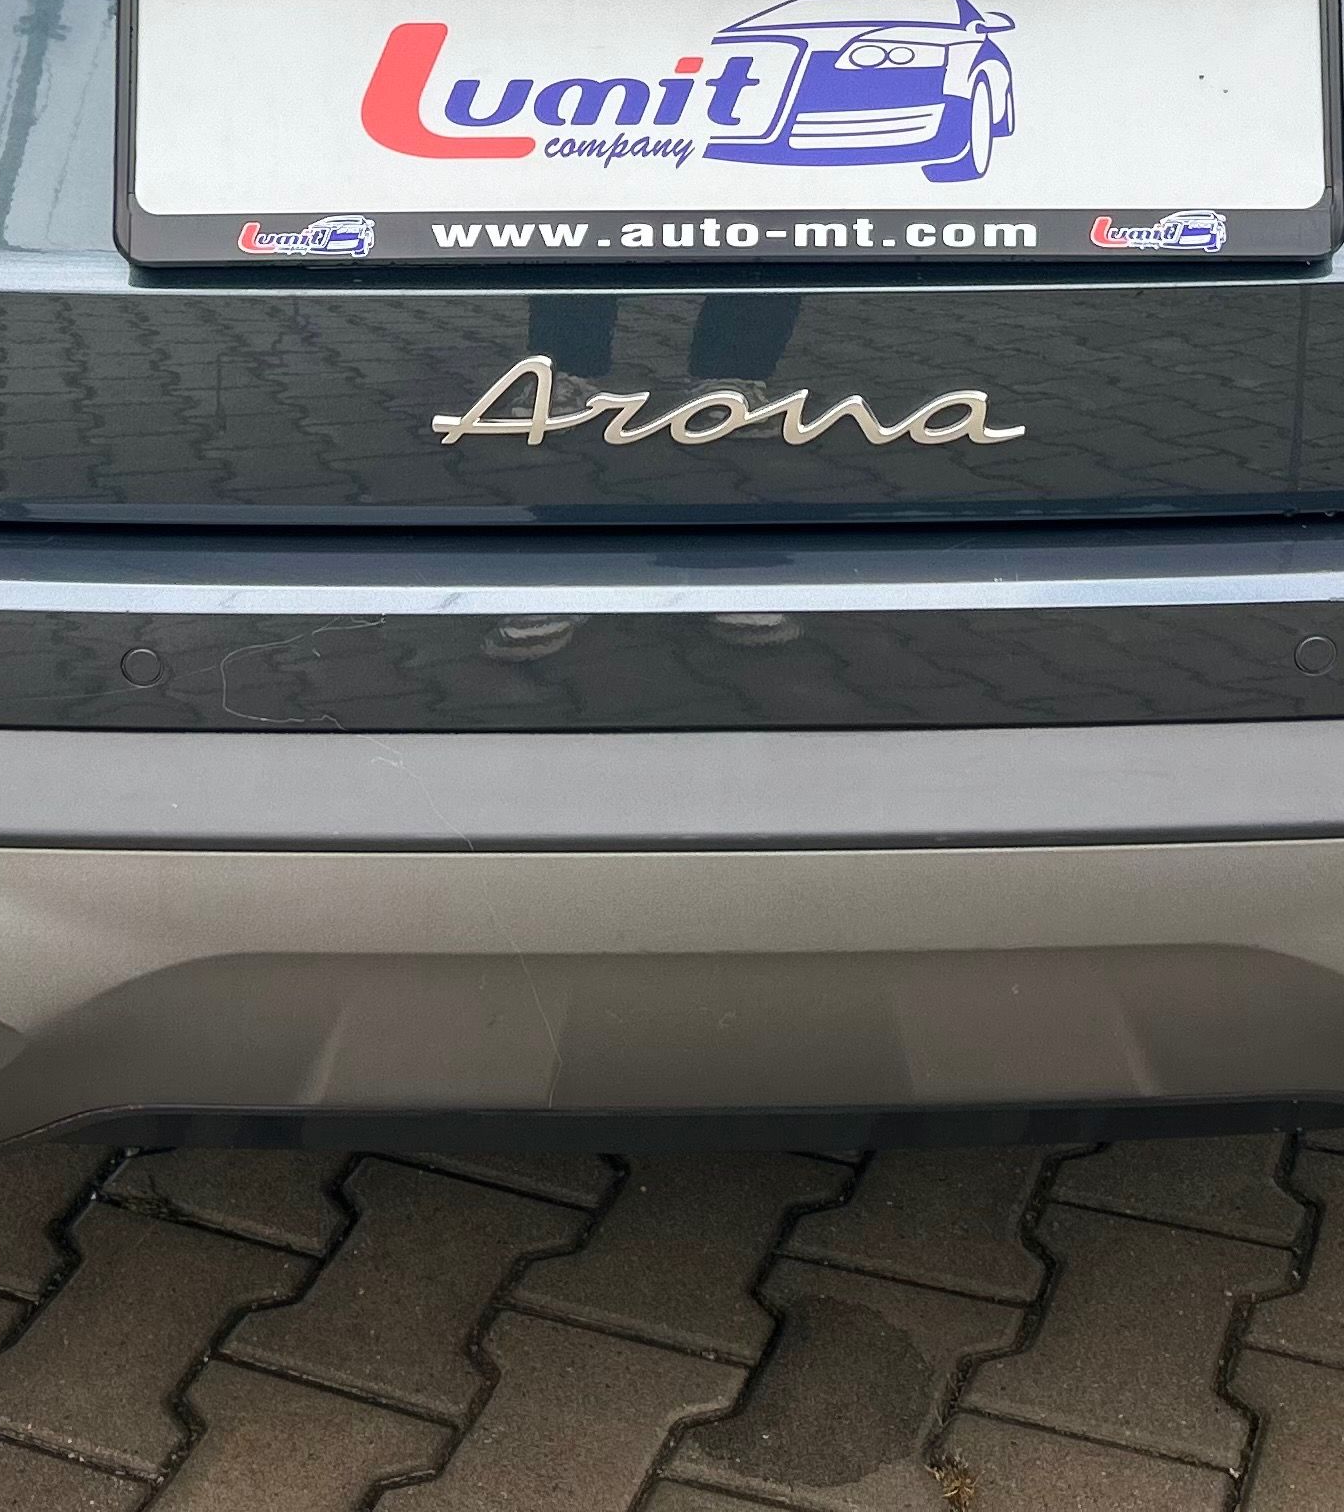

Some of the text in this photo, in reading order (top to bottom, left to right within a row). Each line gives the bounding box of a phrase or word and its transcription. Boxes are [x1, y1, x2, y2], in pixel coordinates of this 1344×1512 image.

[360, 22, 760, 159] Lumit
[543, 132, 696, 169] company
[431, 217, 1039, 249] www.auto-mt.com
[431, 354, 1026, 445] Arona
